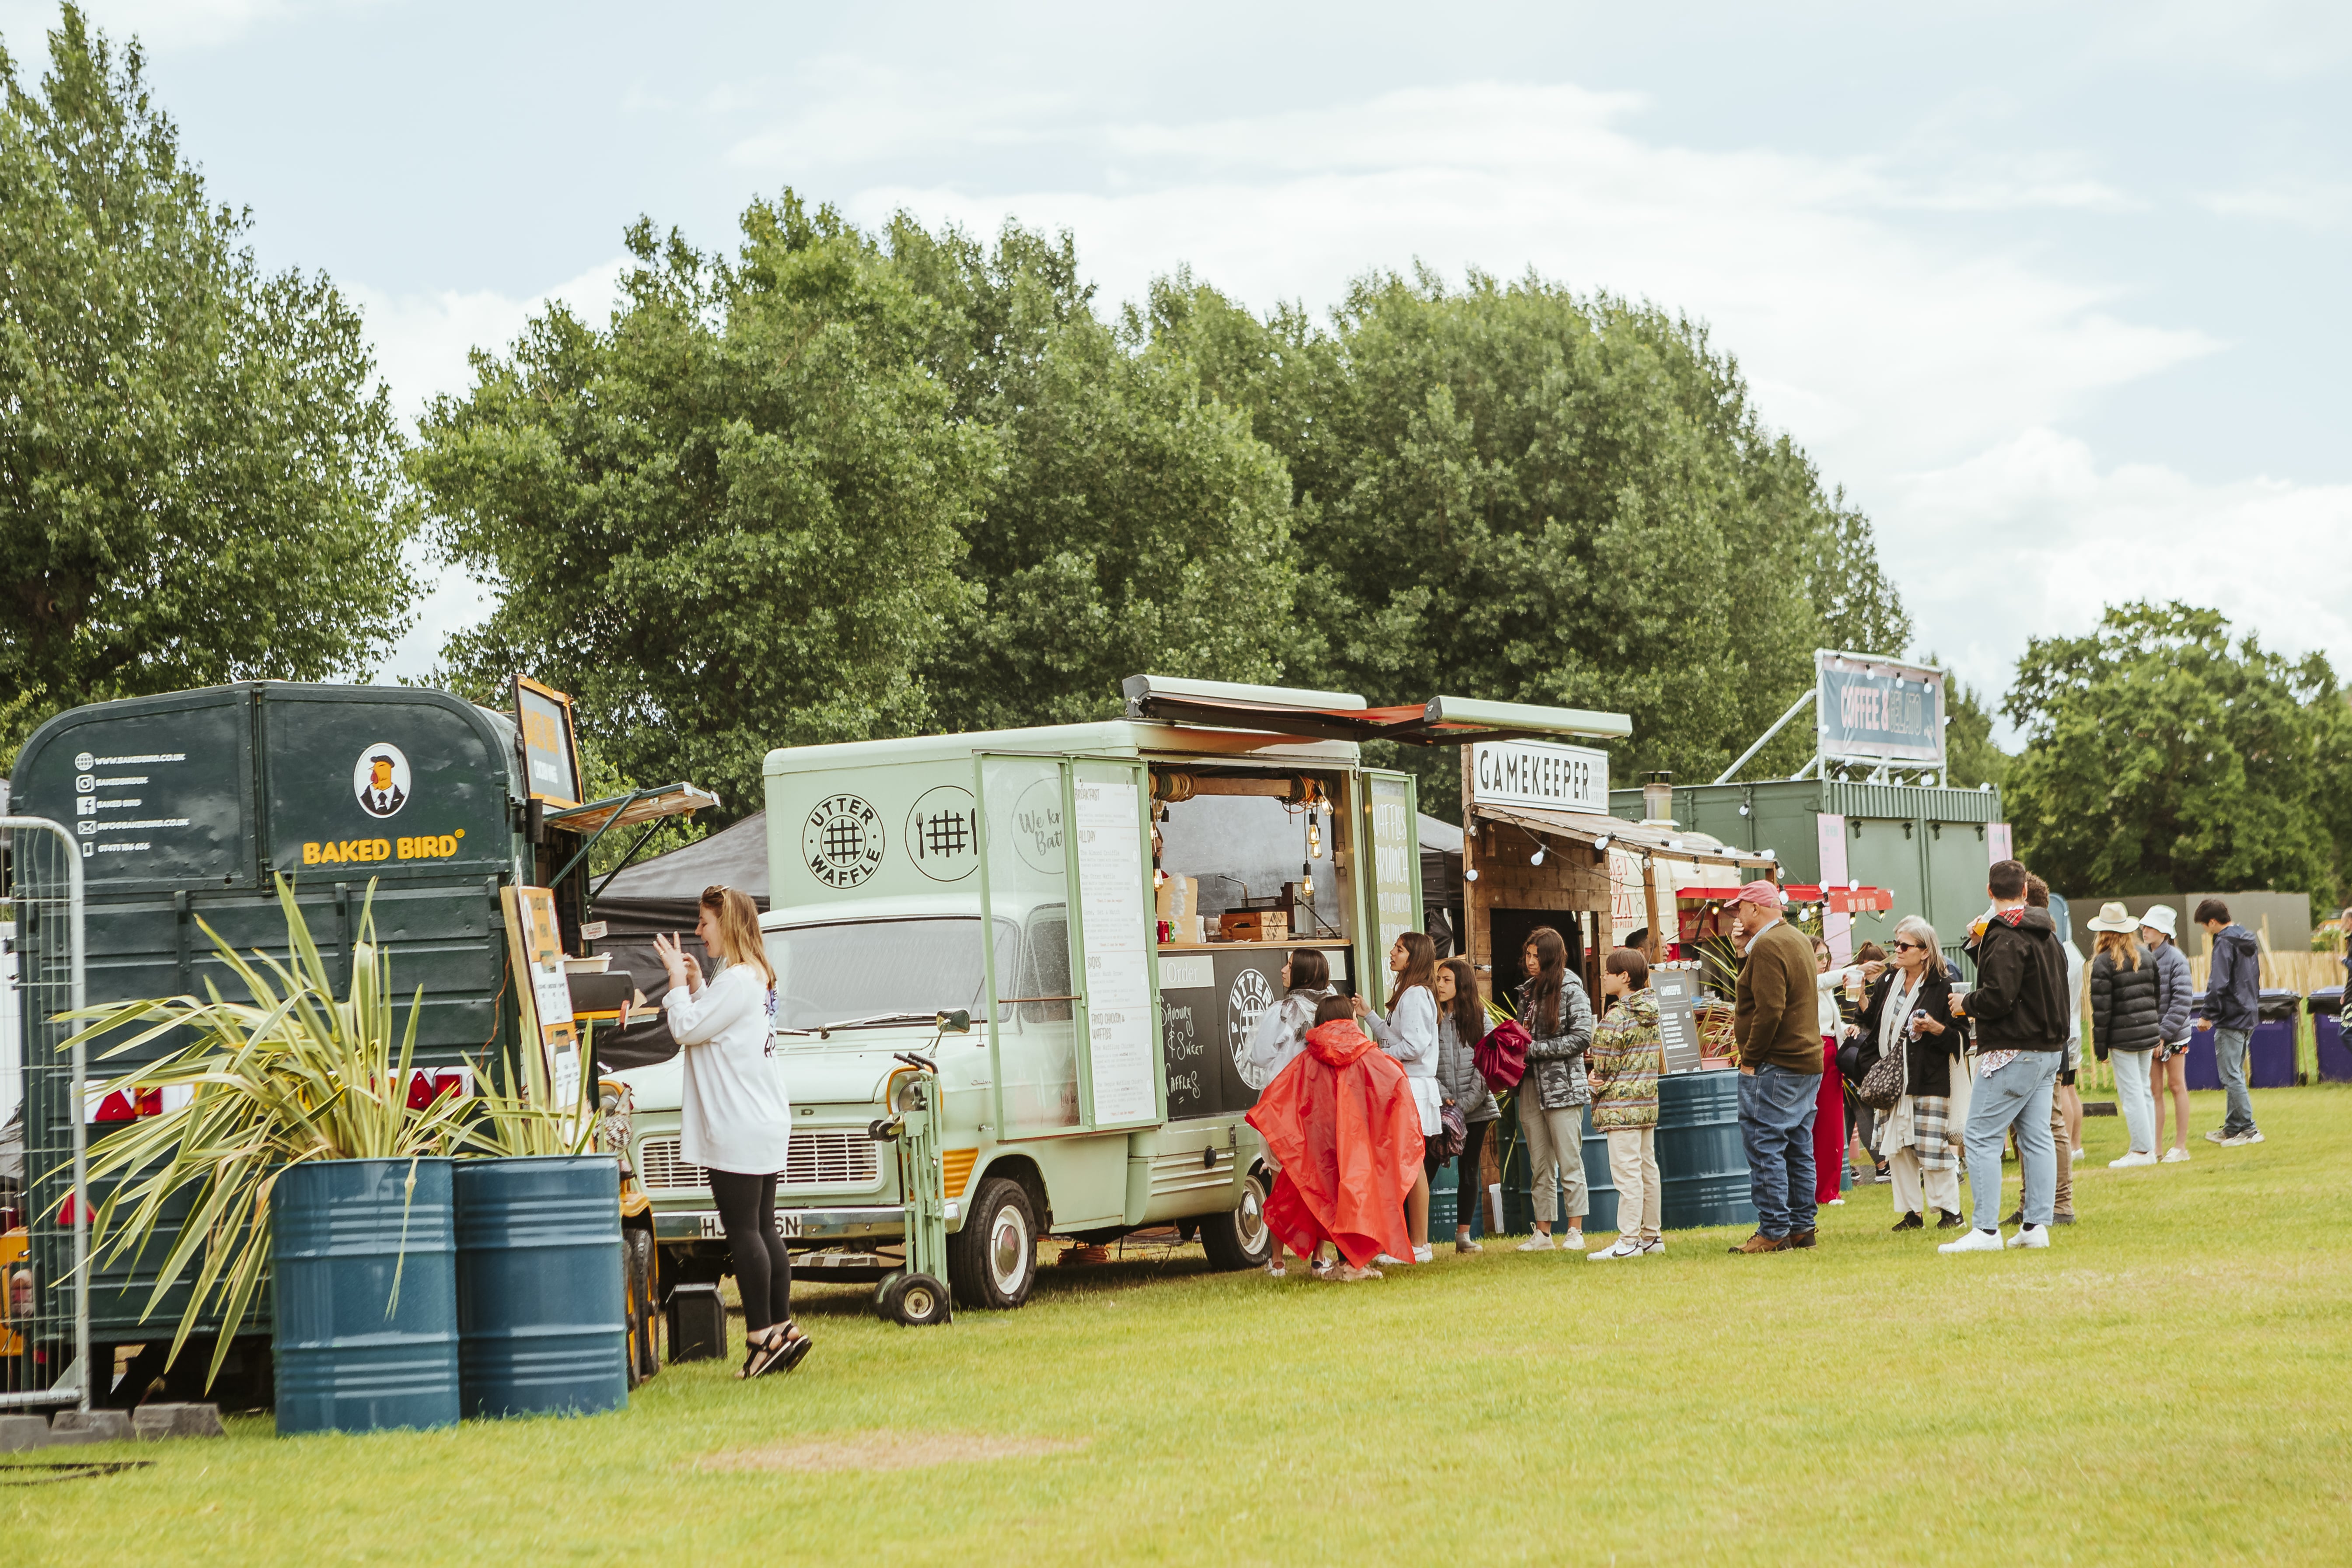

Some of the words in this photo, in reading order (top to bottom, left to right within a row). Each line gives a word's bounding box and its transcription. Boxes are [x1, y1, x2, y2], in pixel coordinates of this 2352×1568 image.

[1841, 685, 1879, 730] COFFEE
[1881, 689, 1889, 731] &
[1889, 690, 1921, 736] GELATO
[95, 754, 186, 765] WWW.BAKEDBIRD.CO.UK
[95, 776, 149, 786] BAKEDBIRDUK
[1480, 750, 1588, 800] GAMEKEEPER
[97, 800, 122, 808] BAKED
[1075, 788, 1099, 801] BREAKFAST
[810, 798, 874, 827] UTTER
[1019, 810, 1044, 834] We
[303, 838, 391, 864] BAKED
[397, 835, 457, 859] BIRD
[811, 848, 880, 885] WAFFLE
[1377, 892, 1389, 915] RIED
[1391, 892, 1412, 915] CHICKEN
[1380, 923, 1390, 945] ASH
[1087, 956, 1101, 969] SIDES
[1166, 962, 1198, 983] Order
[1232, 973, 1272, 1010] UTTER
[1660, 985, 1682, 996] GAMEKEEPER
[1091, 1013, 1103, 1026] FRIED
[1105, 1012, 1121, 1025] CHICKEN
[1092, 1028, 1112, 1040] WAFFLES
[1177, 1031, 1204, 1060] SWEET
